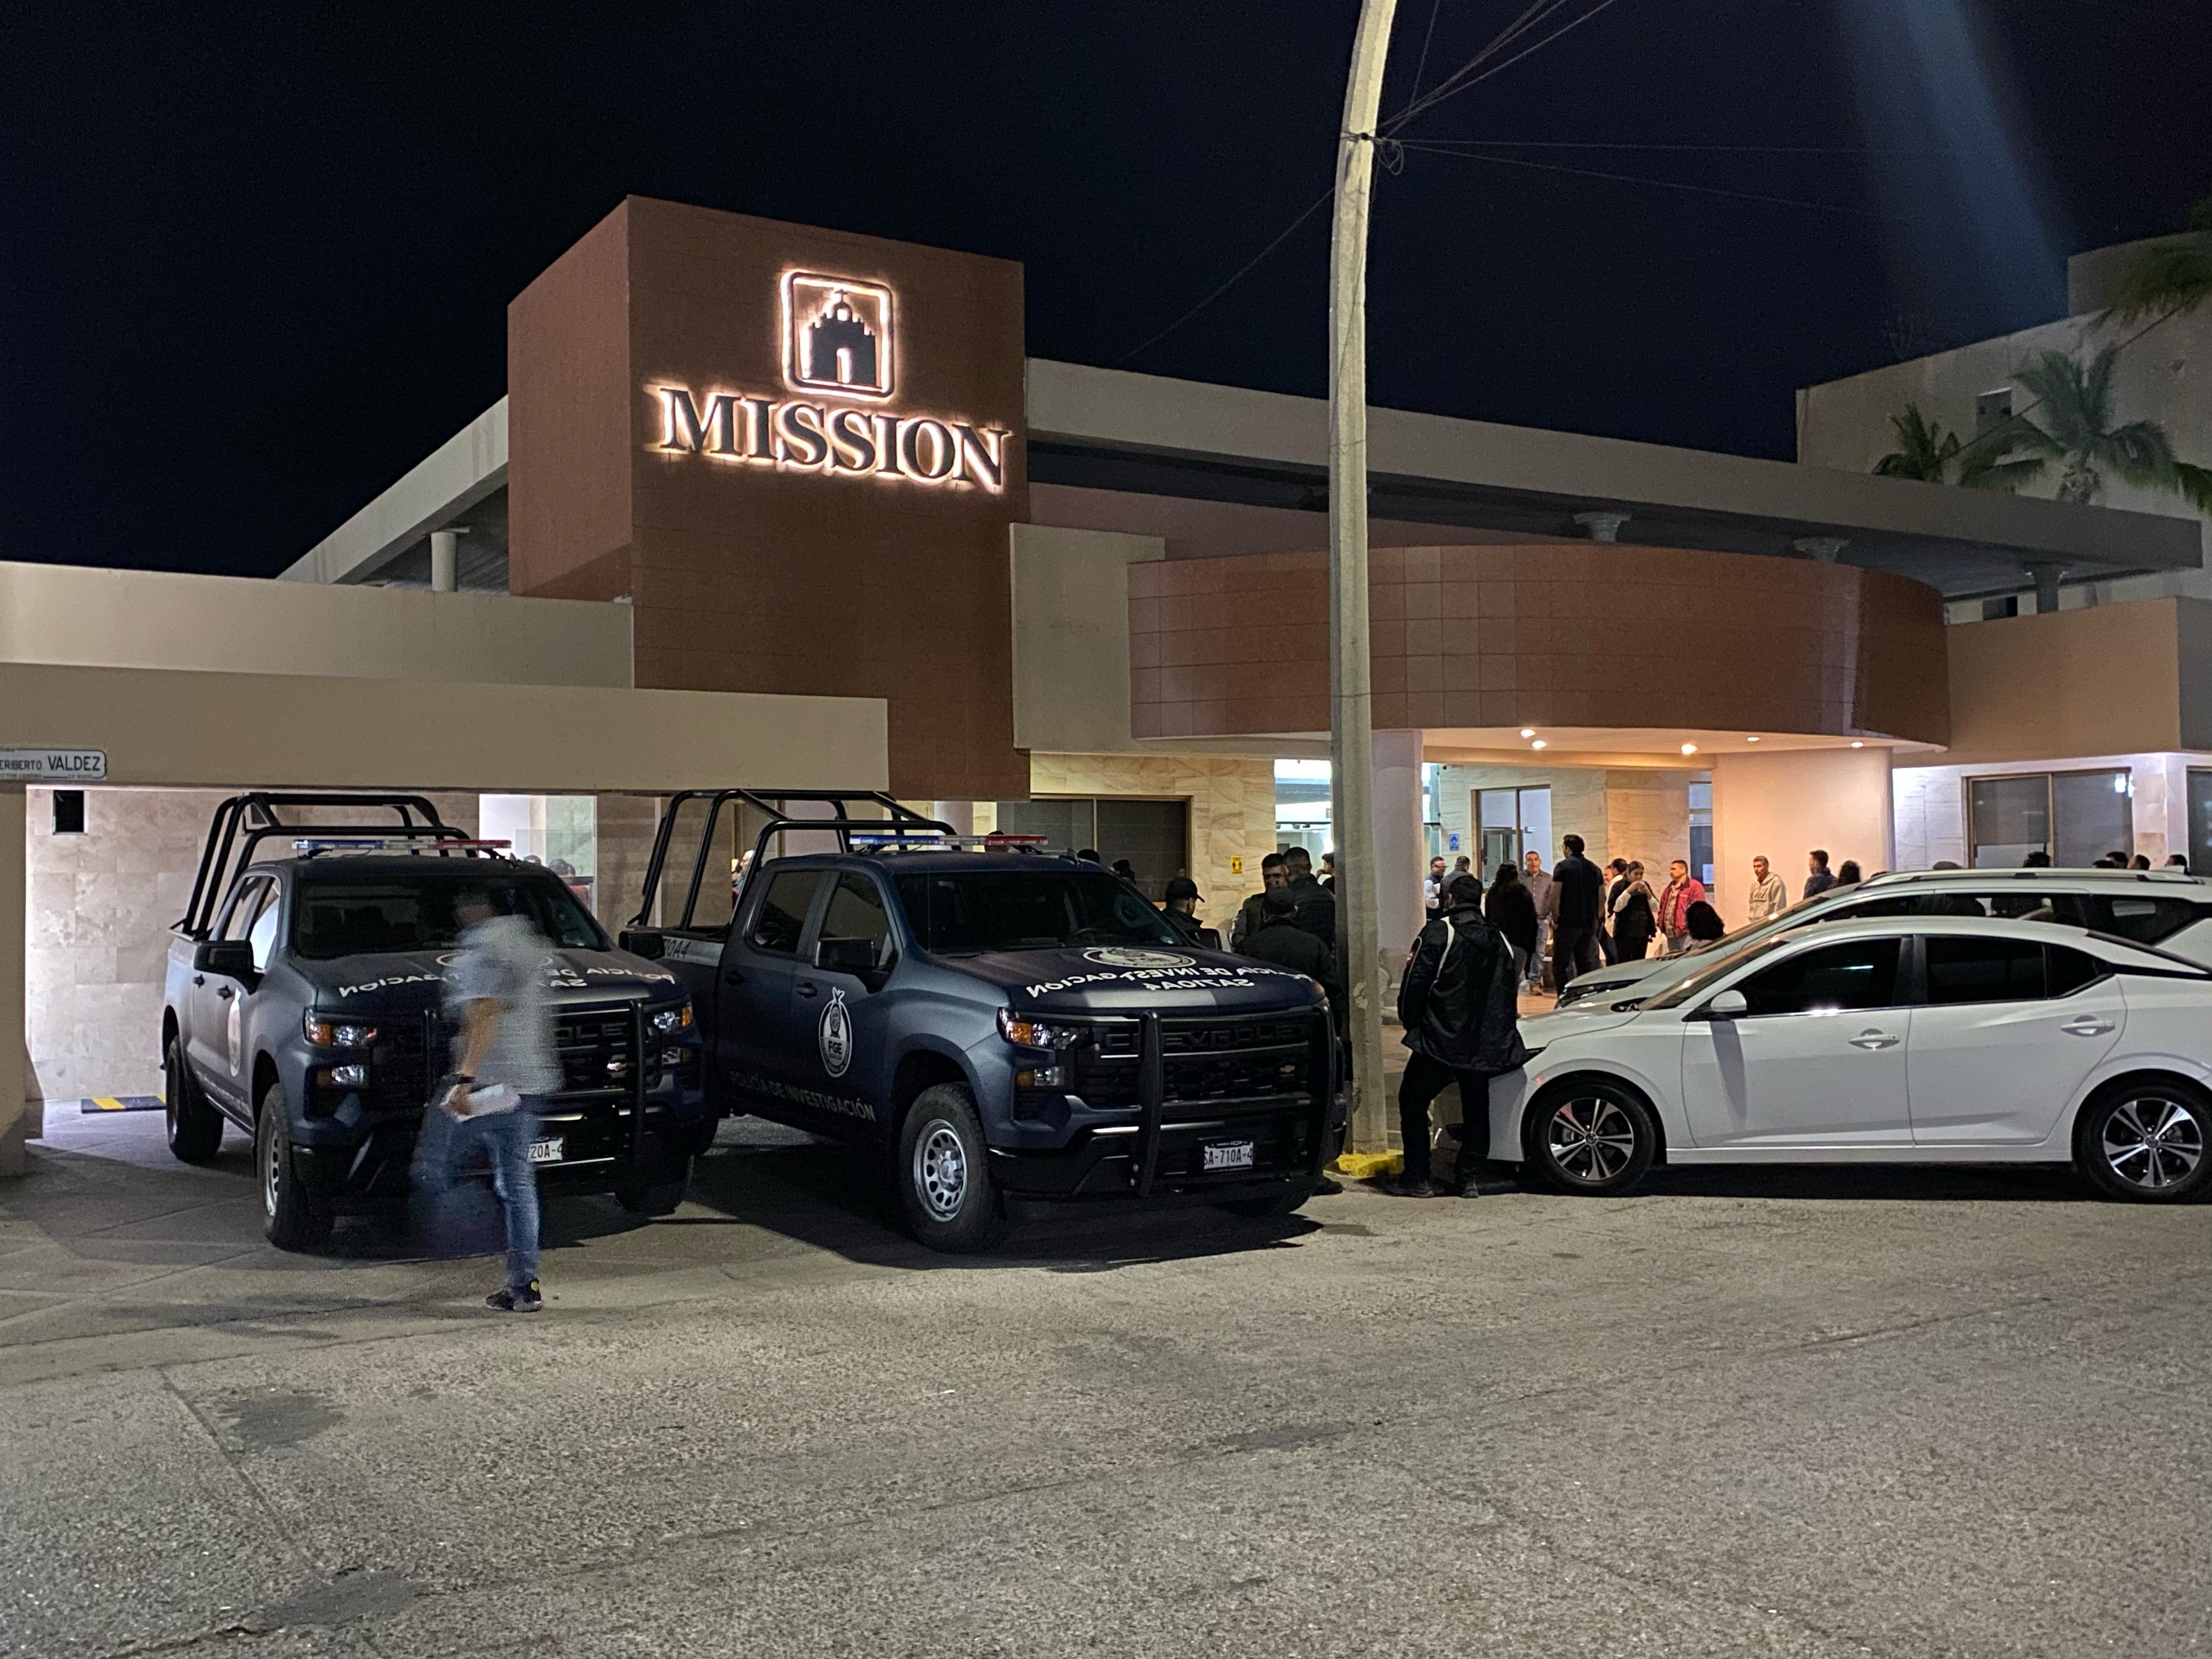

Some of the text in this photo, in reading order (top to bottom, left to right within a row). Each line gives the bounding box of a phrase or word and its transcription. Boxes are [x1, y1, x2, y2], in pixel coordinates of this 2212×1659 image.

[659, 387, 1009, 486] MISSION
[0, 755, 100, 771] ERIBERTO VALDEZ
[828, 1040, 842, 1054] FGE
[785, 1085, 876, 1121] INVESTIGACIÓN
